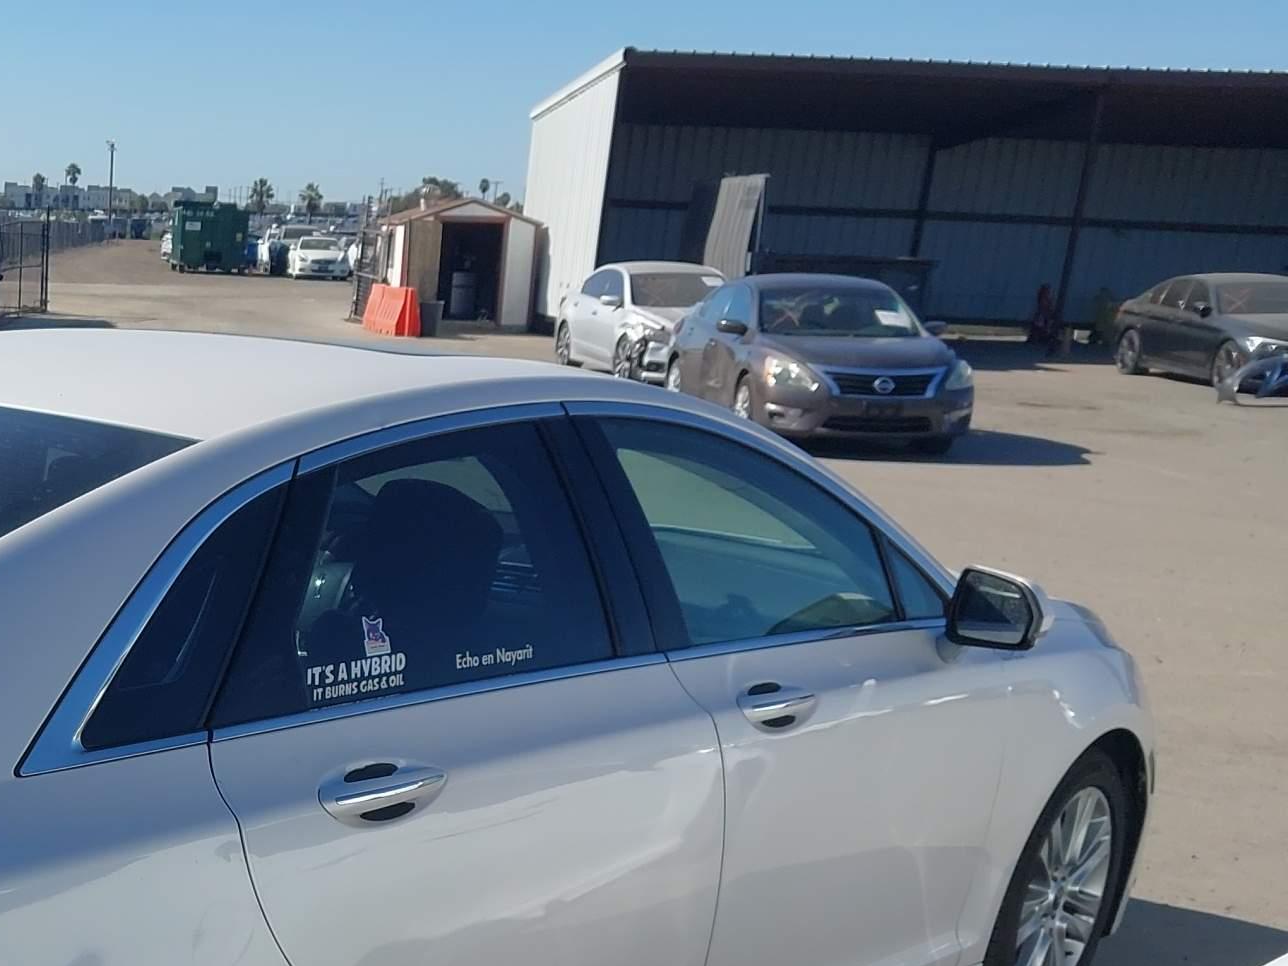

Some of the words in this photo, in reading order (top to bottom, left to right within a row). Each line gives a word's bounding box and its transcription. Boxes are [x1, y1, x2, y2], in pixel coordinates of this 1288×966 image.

[306, 664, 335, 686] IT'S
[338, 662, 348, 682] A
[351, 653, 406, 679] HYBRID
[456, 651, 480, 669] Echo
[482, 653, 494, 666] en
[497, 644, 534, 666] Nayarit
[313, 688, 323, 701] IT
[325, 681, 359, 699] BURNS
[360, 677, 380, 693] GAS
[380, 675, 389, 689] &
[389, 673, 404, 687] OIL
